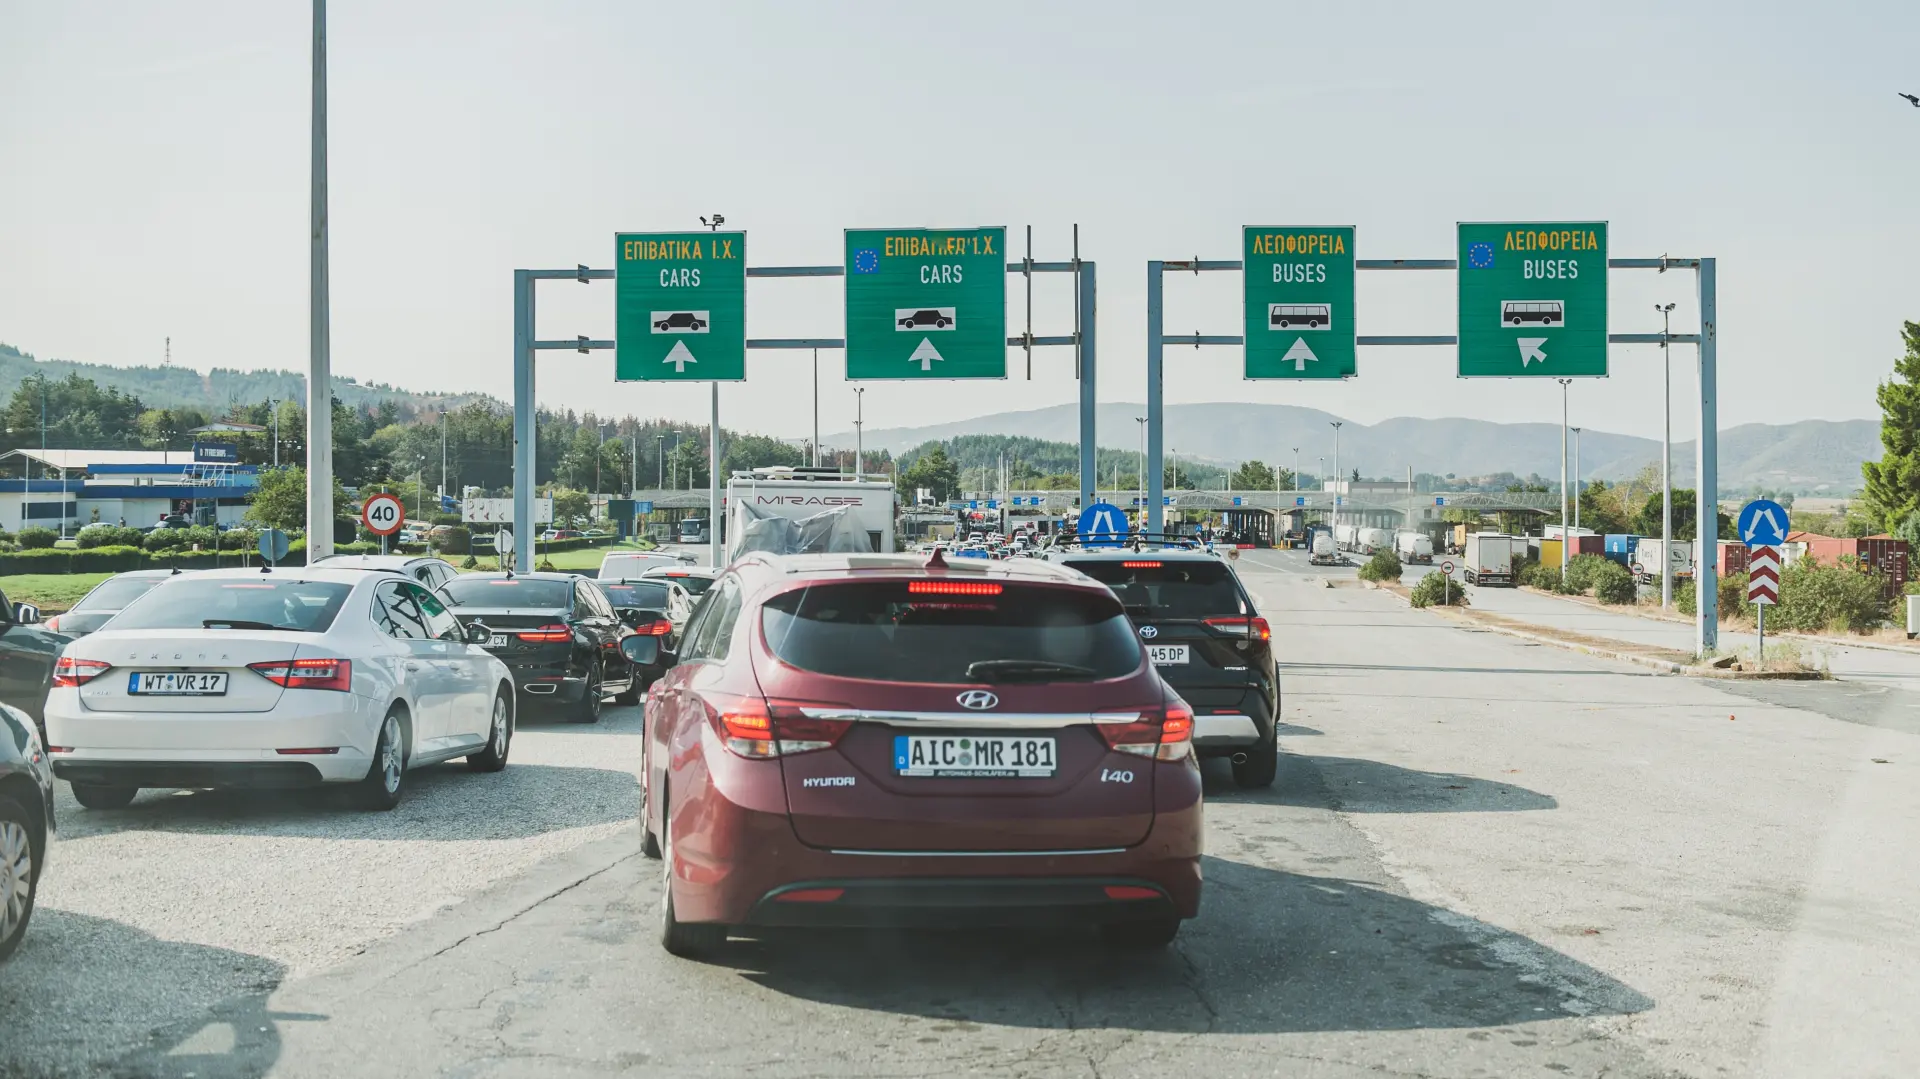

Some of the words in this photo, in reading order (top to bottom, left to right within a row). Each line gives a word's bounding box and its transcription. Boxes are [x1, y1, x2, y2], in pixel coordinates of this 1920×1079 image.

[624, 240, 702, 260] ΕΠΙΒΑΤΙΚΑ
[1253, 234, 1345, 255] ΛΕΩΦΟΡΕΙΑ
[1504, 230, 1598, 251] ΛΕΩΦΟΡΕΙΑ
[660, 268, 701, 288] CARS
[920, 264, 963, 284] CARS
[1272, 263, 1326, 283] BUSES
[1523, 259, 1578, 279] BUSES
[757, 495, 863, 506] MIRAGE
[371, 505, 394, 522] 40
[494, 636, 505, 645] CX
[1151, 648, 1166, 661] 45
[1169, 648, 1184, 661] DP
[145, 675, 166, 690] WT
[176, 675, 196, 690] VR
[199, 675, 220, 690] 17
[911, 740, 956, 766] AIC
[974, 740, 1005, 767] MR
[1010, 740, 1054, 767] 181
[803, 776, 856, 788] HYUNDAI
[1101, 768, 1134, 783] i40
